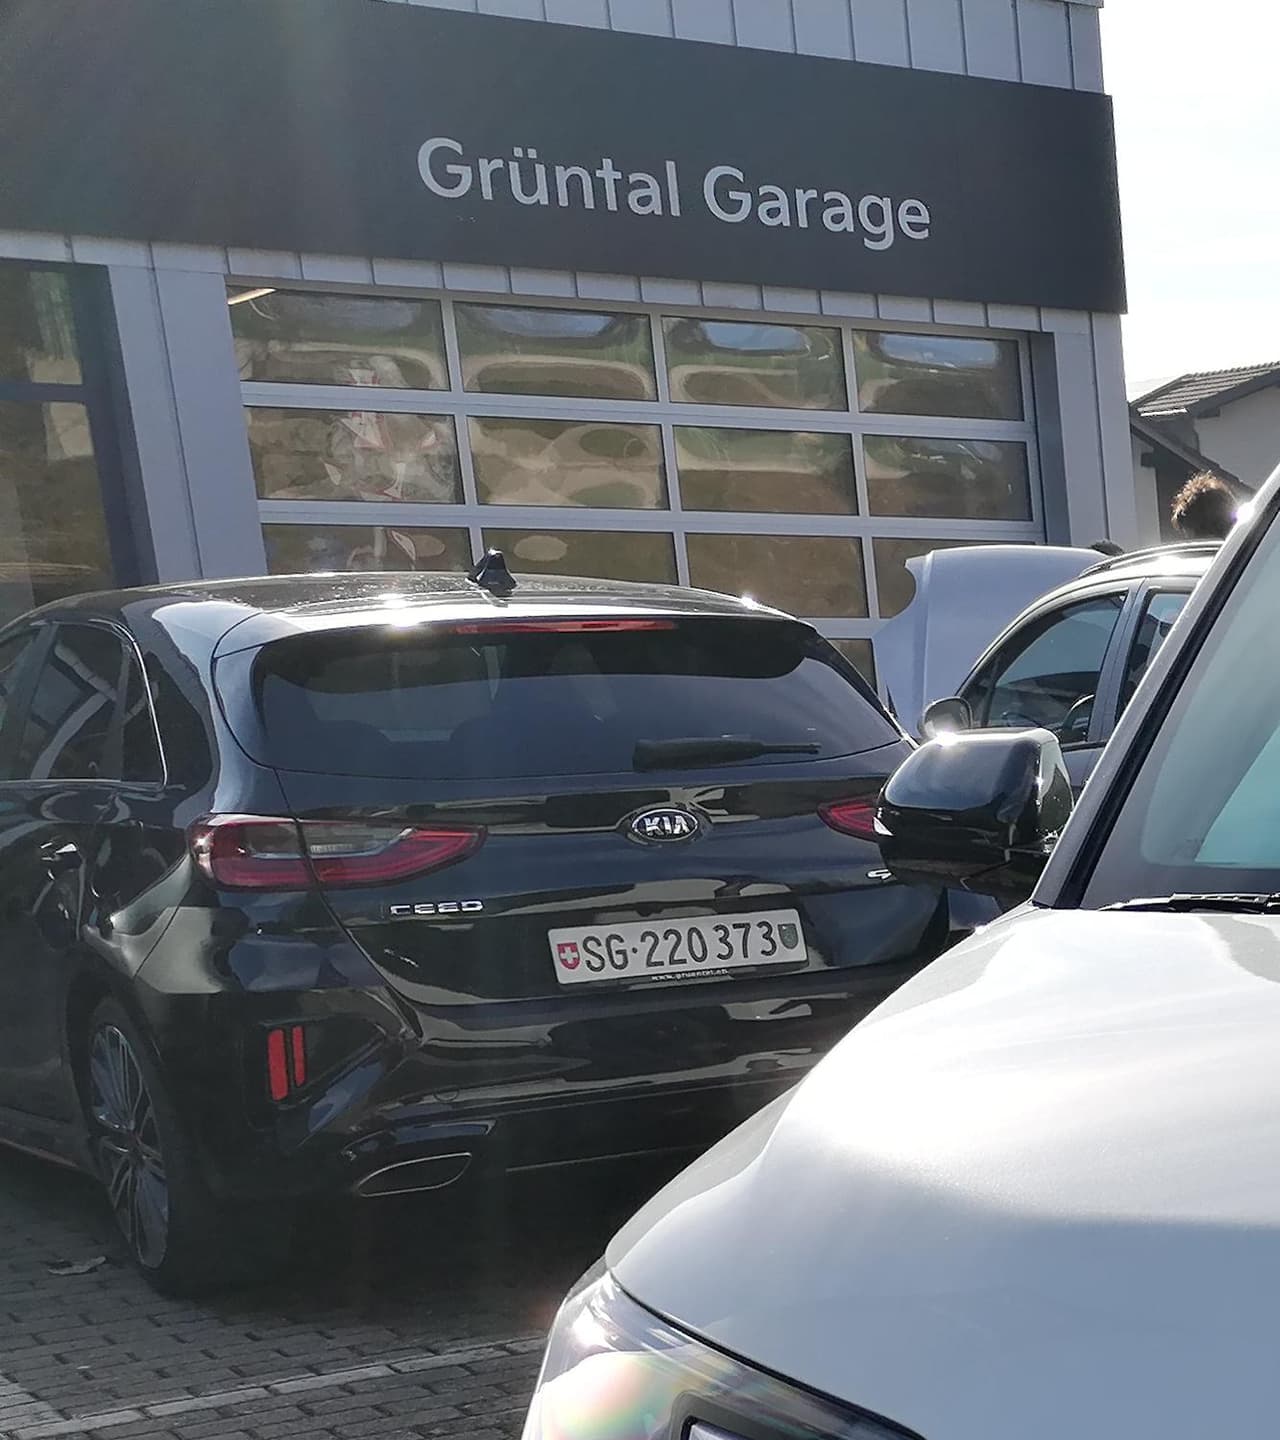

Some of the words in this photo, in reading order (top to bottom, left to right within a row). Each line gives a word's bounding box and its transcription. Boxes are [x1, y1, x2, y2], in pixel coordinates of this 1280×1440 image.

[416, 136, 682, 218] Grüntal
[702, 164, 931, 251] Garage
[642, 814, 691, 837] KIA
[390, 899, 484, 916] CEED
